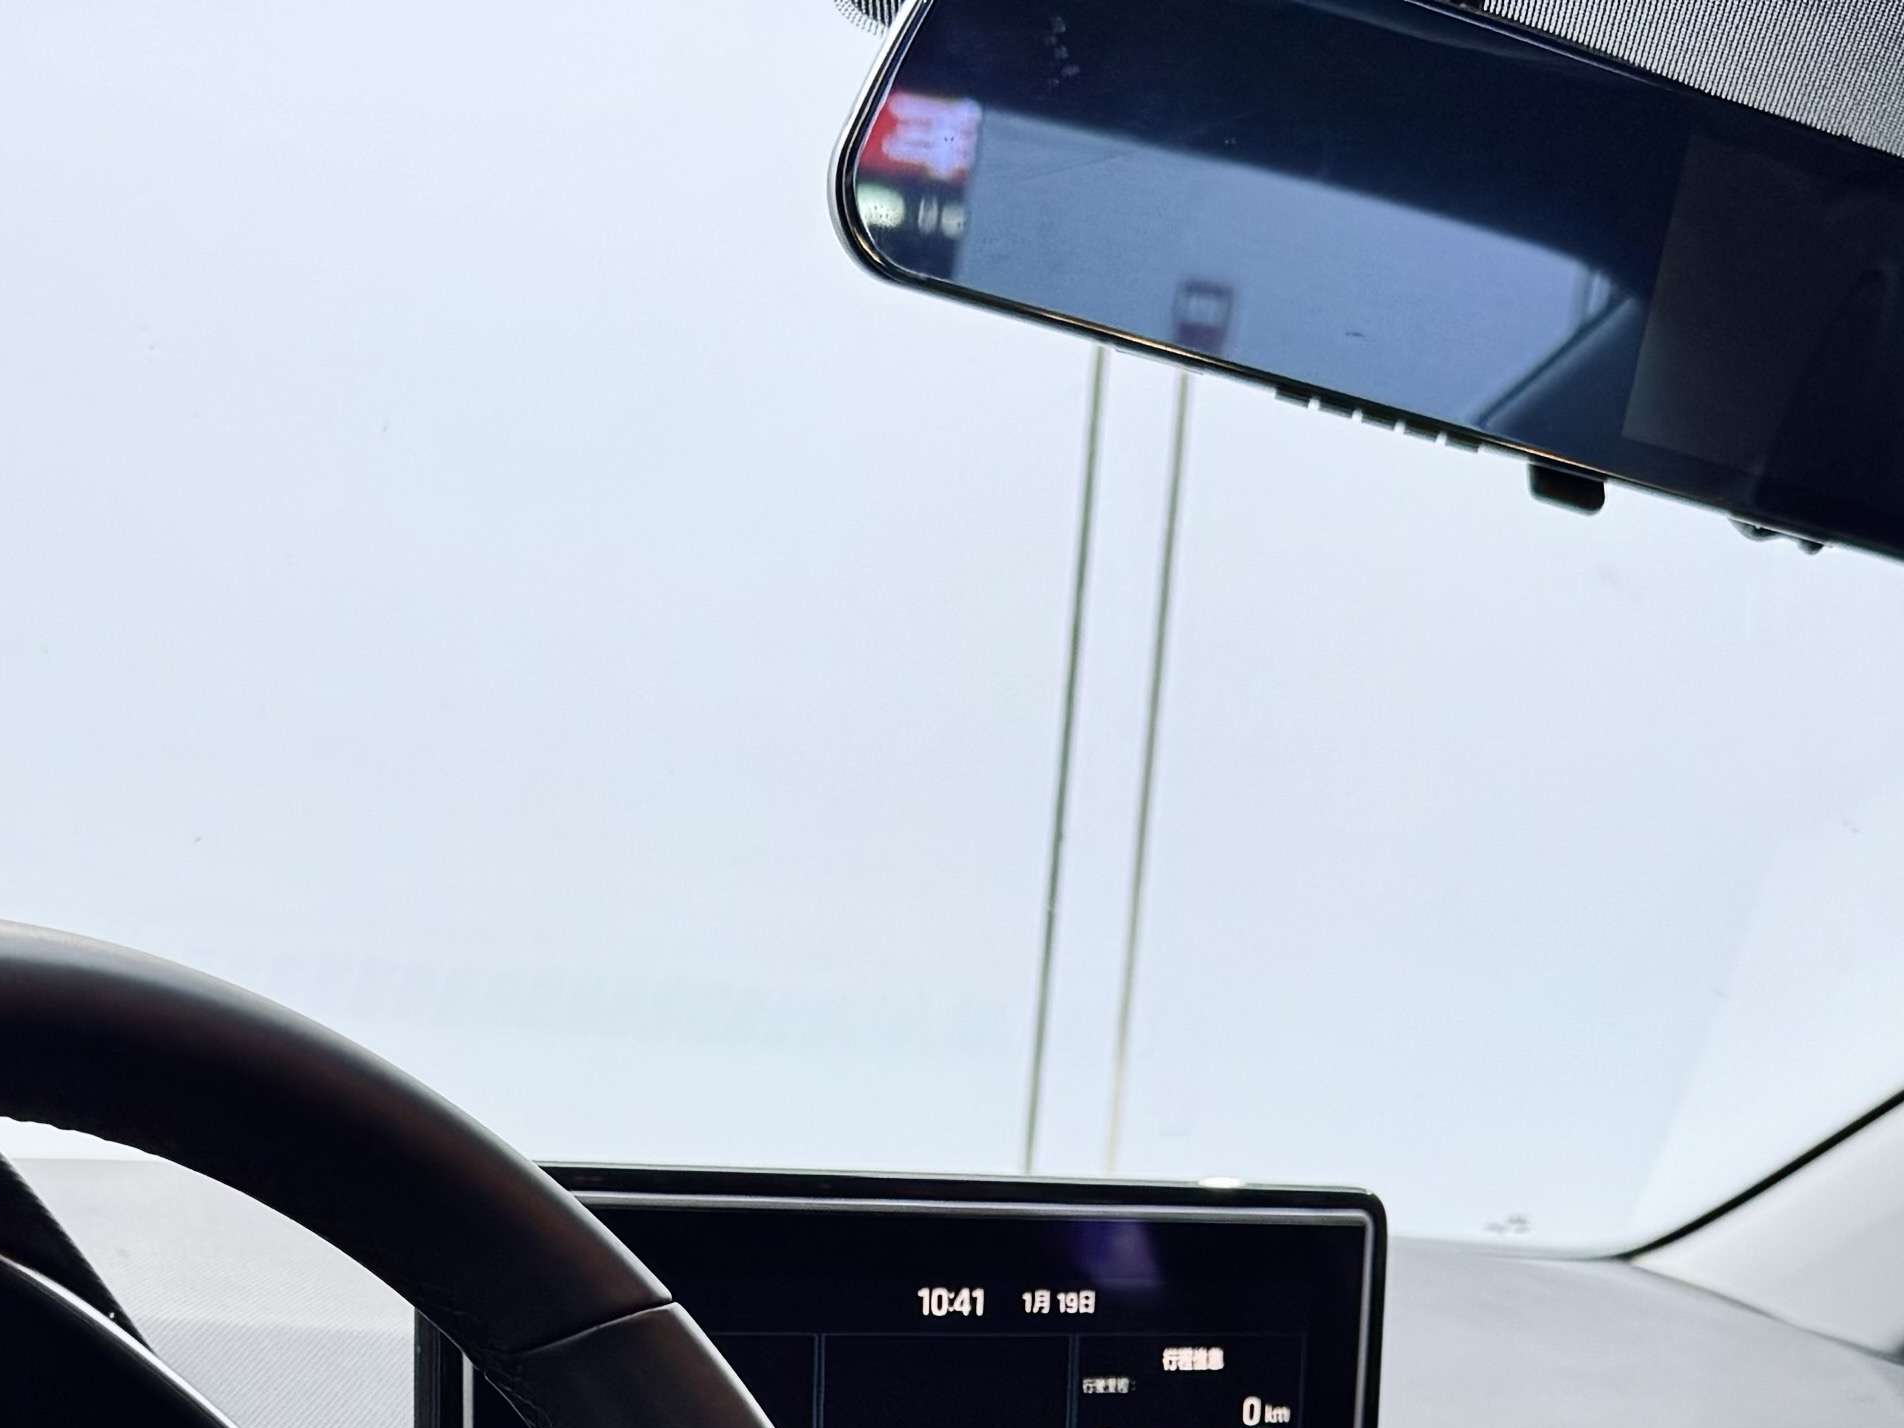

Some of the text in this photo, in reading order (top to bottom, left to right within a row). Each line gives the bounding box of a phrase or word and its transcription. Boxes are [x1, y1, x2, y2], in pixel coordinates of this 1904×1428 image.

[917, 1287, 985, 1317] 10:41
[1243, 1396, 1291, 1427] 0 km
